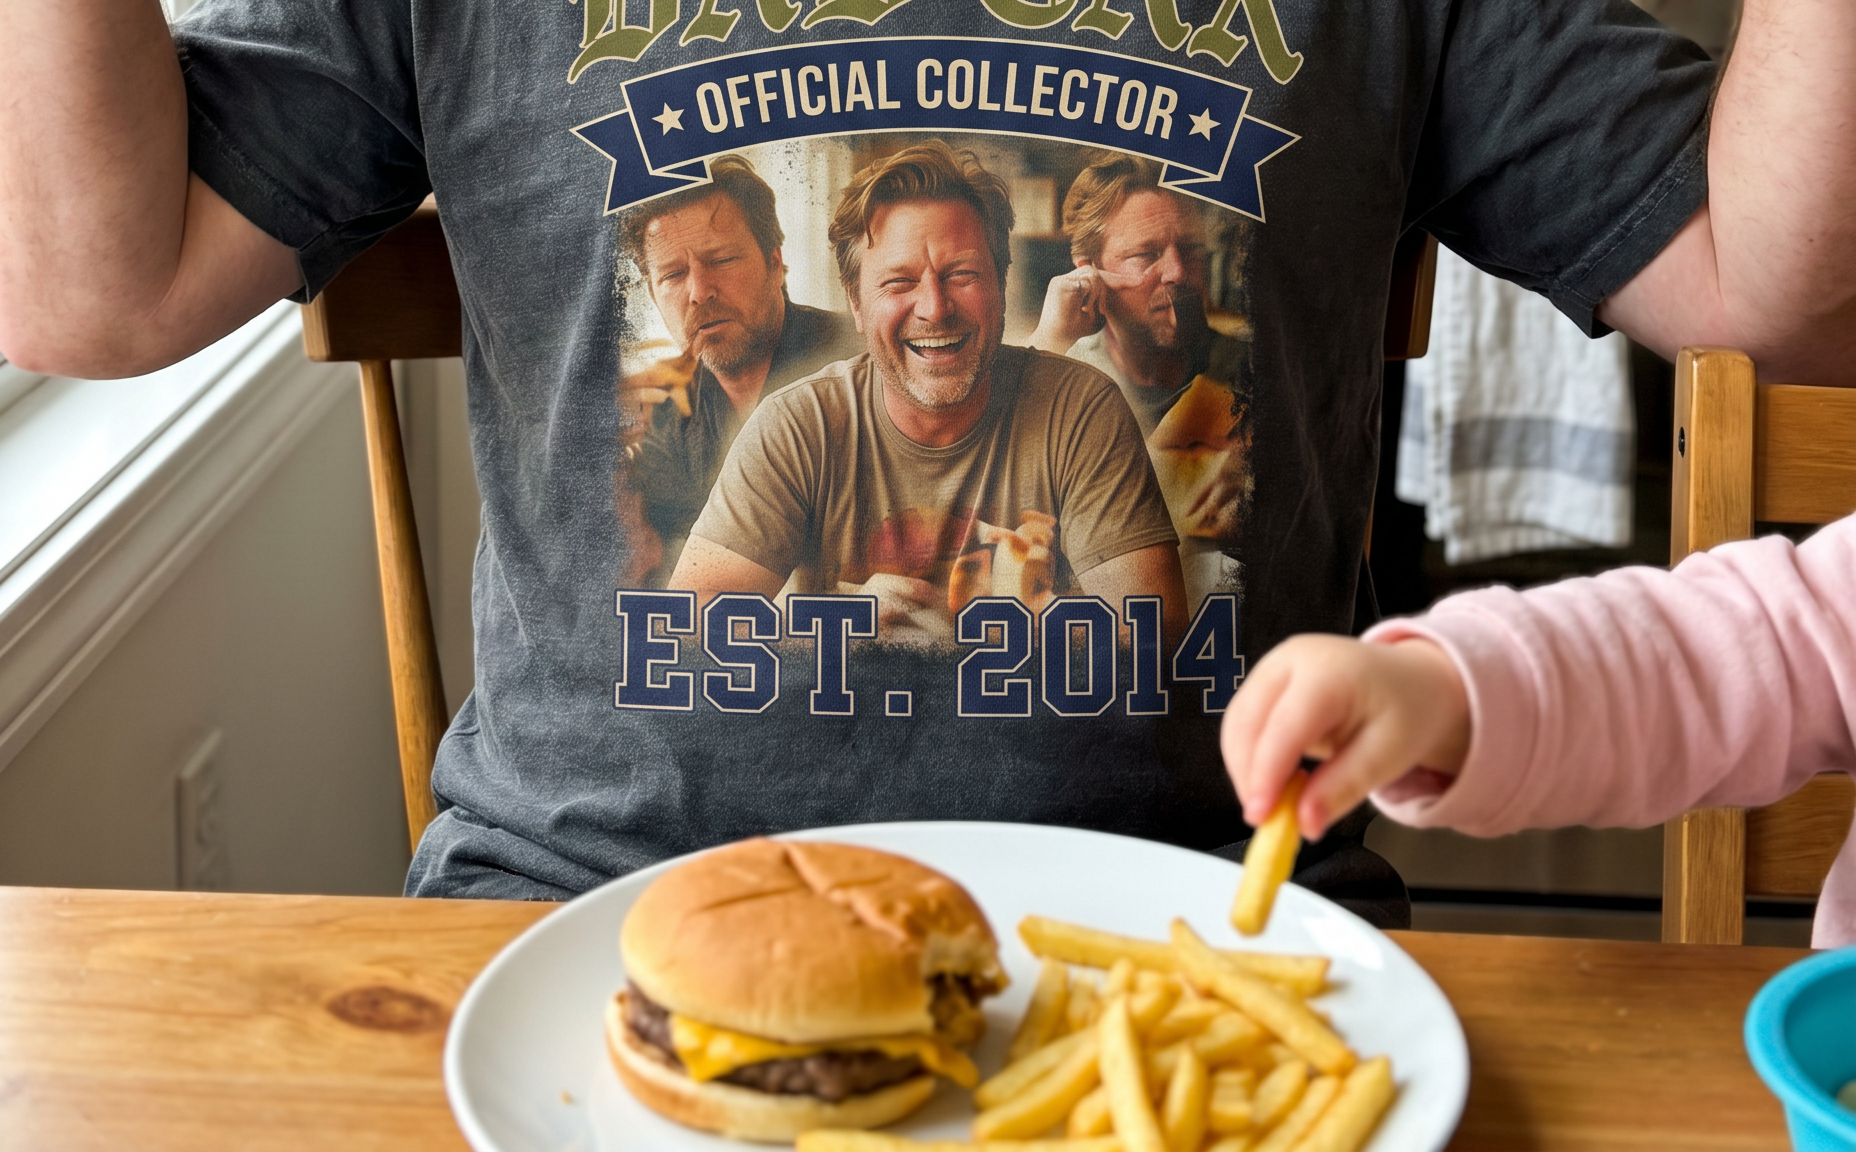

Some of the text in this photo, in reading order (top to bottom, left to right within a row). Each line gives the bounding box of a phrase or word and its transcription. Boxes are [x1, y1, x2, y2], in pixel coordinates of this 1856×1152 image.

[695, 58, 1179, 140] OFFICIAL COLLECTOR
[613, 589, 1246, 718] EST. 2014
